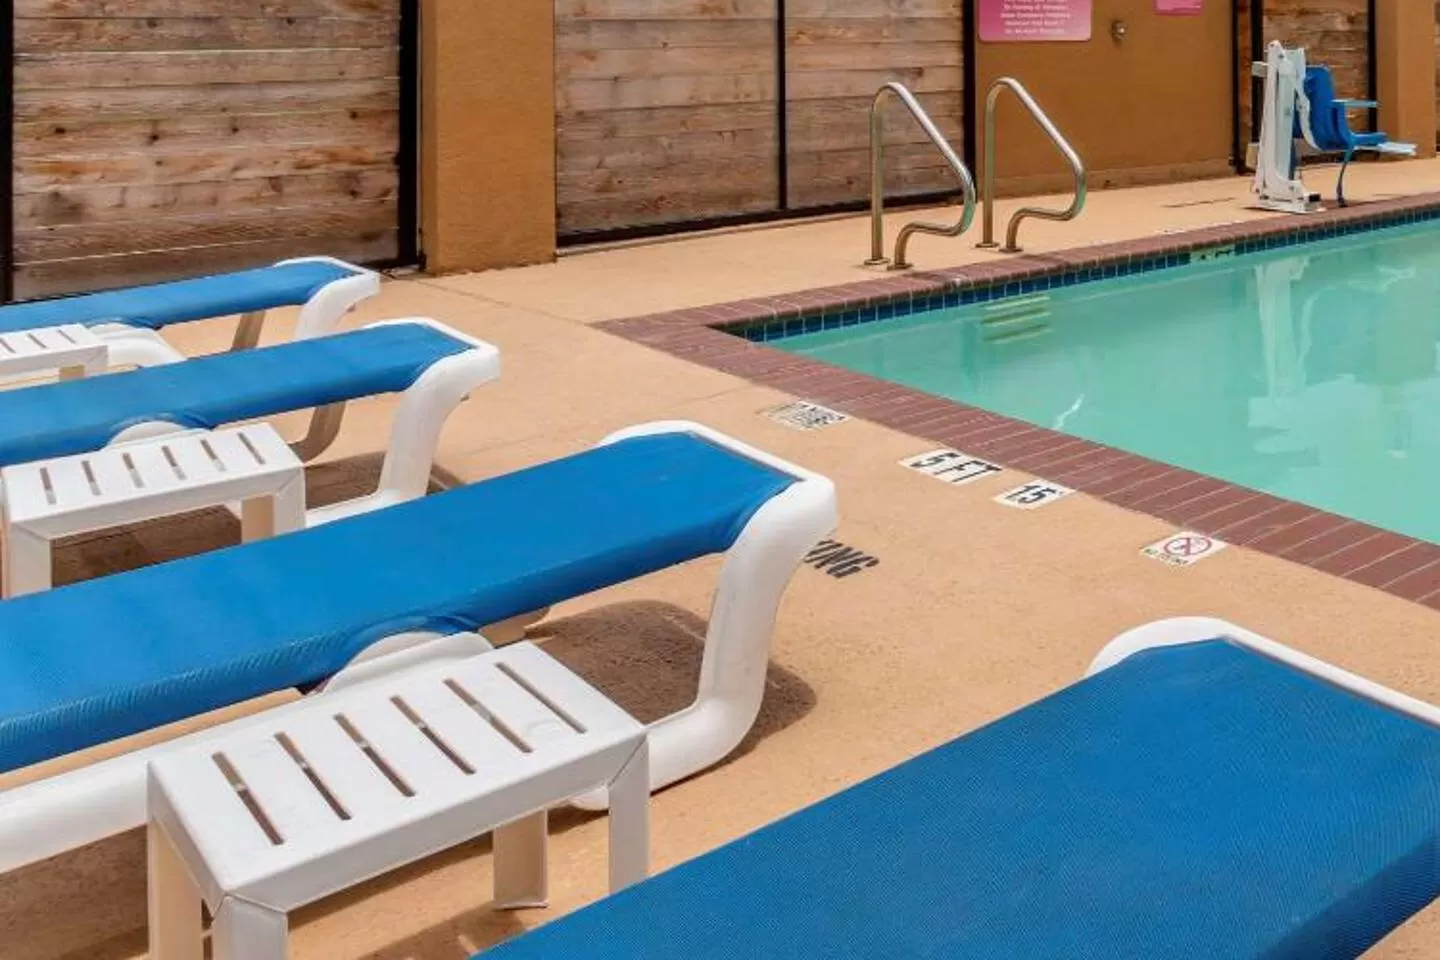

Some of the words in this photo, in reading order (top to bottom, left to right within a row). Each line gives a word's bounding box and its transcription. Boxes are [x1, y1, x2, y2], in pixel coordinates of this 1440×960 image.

[909, 451, 961, 469] 5
[931, 459, 1003, 483] FT
[1004, 484, 1058, 504] 15
[803, 539, 881, 579] ING
